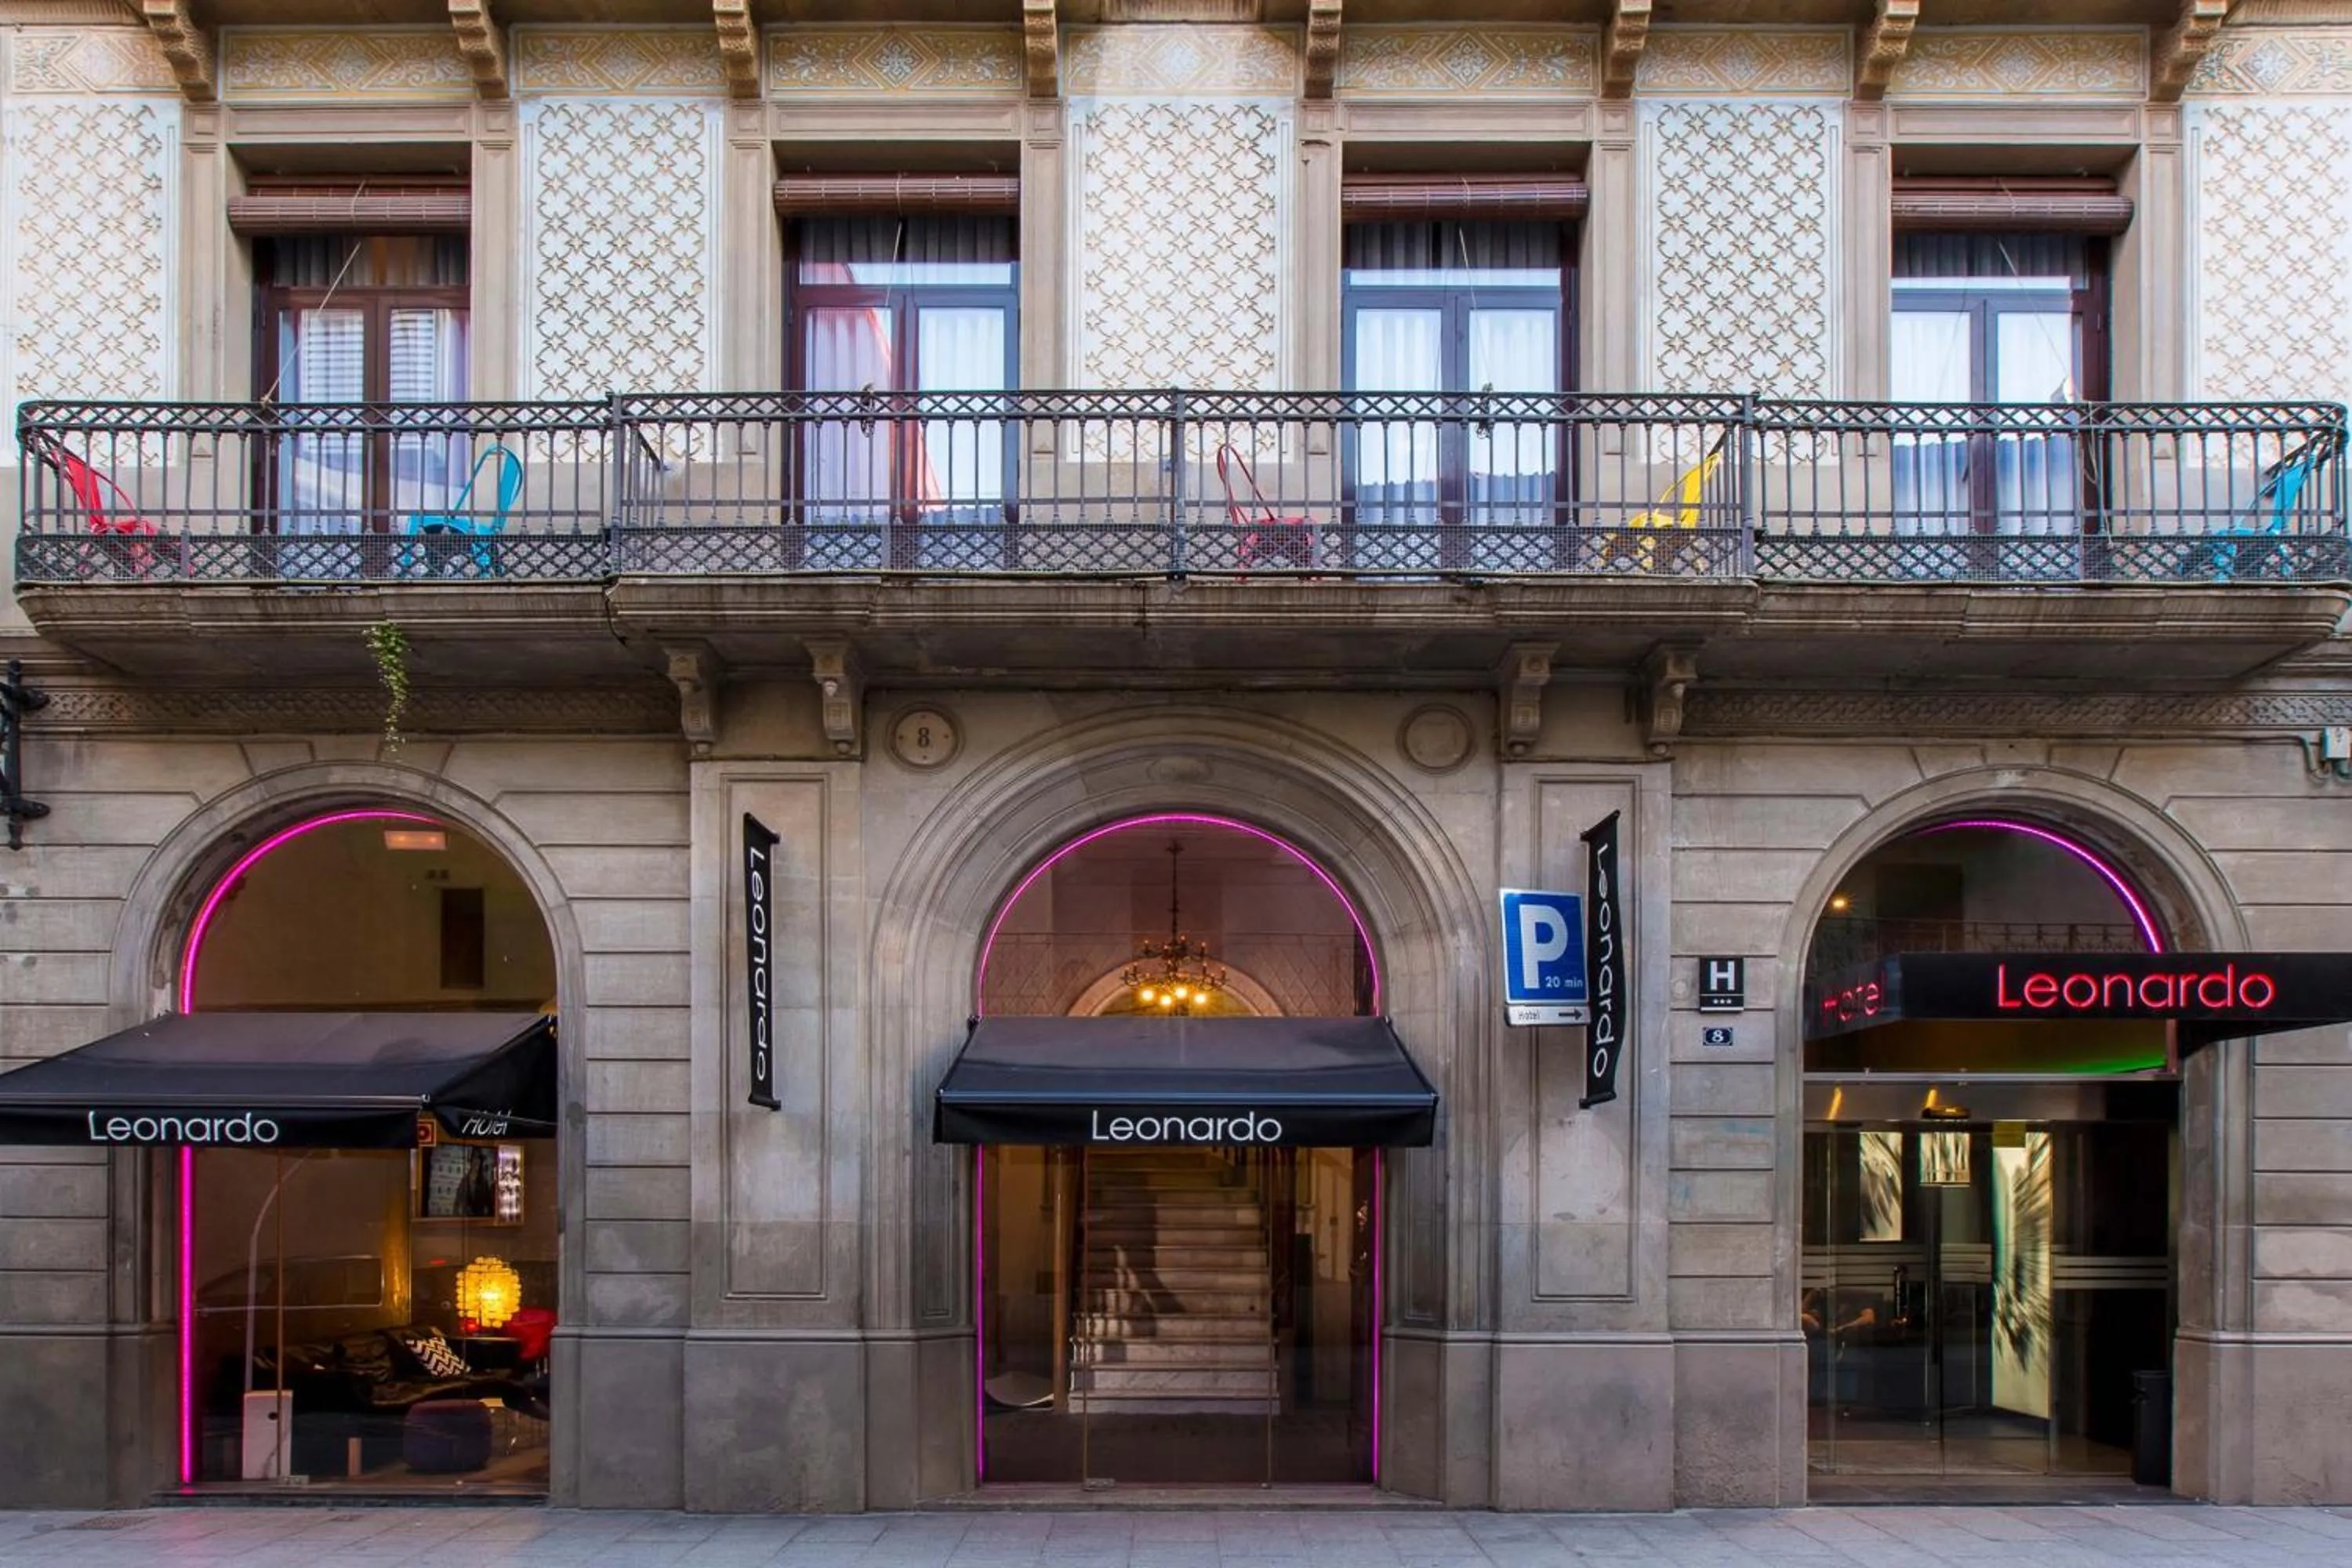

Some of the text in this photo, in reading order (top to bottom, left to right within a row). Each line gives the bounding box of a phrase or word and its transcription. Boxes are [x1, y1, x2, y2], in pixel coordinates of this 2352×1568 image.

[917, 727, 930, 748] 8
[1519, 904, 1567, 989] P
[1593, 844, 1614, 1077] Leonardo
[750, 846, 768, 1081] Leonardo
[1710, 960, 1735, 991] H
[1545, 975, 1583, 988] 20 min
[1997, 964, 2275, 1008] Leonardo
[1711, 1029, 1724, 1042] 8
[89, 1110, 279, 1142] Leonardo
[1092, 1109, 1283, 1142] Leonardo
